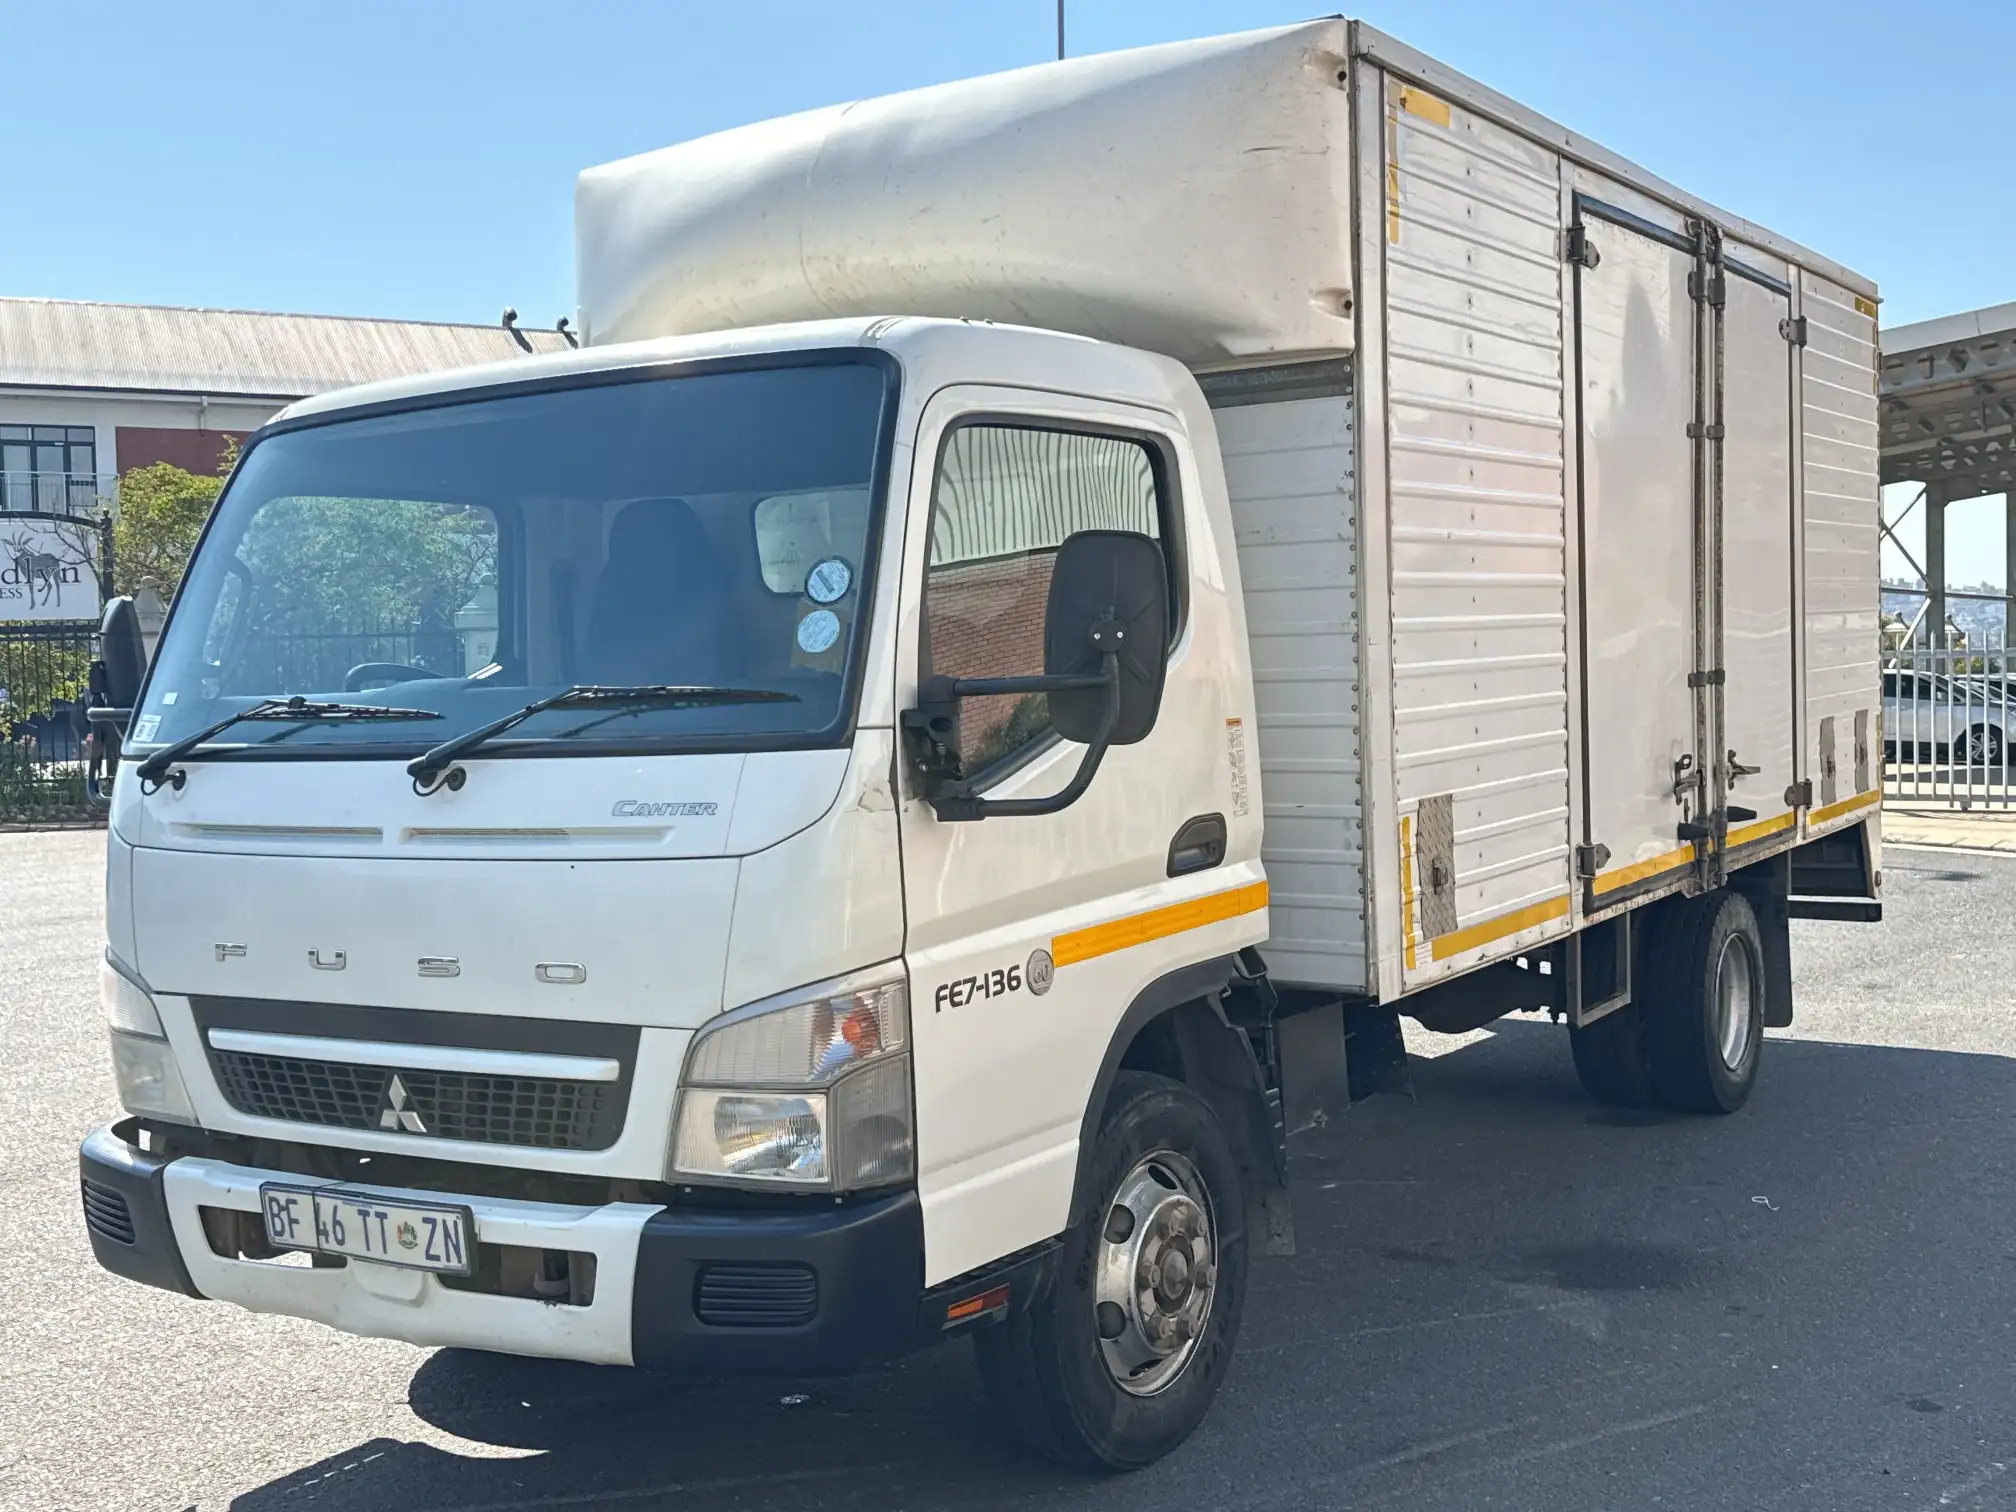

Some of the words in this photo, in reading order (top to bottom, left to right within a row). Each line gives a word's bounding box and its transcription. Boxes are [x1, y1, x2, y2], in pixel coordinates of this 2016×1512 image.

[214, 941, 588, 985] FUSO
[935, 963, 1022, 1013] FE7-136
[268, 1196, 300, 1240] BF
[316, 1202, 346, 1247] 46
[357, 1208, 389, 1255] TT
[421, 1216, 463, 1265] ZN
